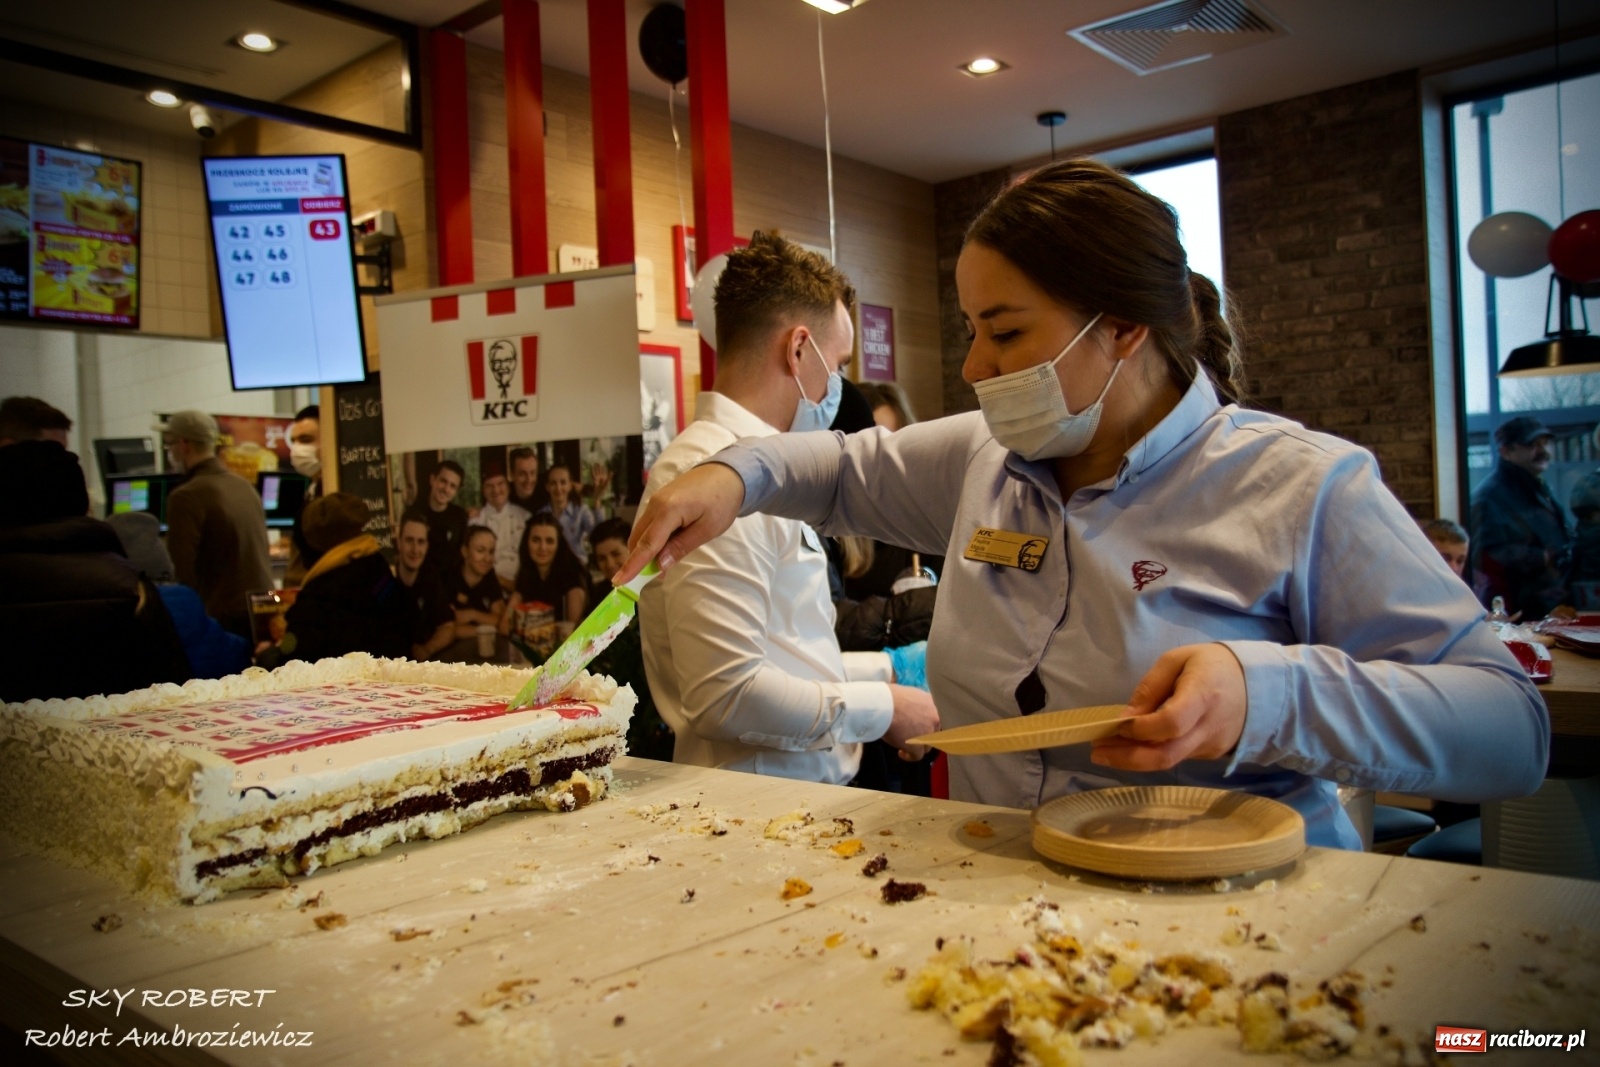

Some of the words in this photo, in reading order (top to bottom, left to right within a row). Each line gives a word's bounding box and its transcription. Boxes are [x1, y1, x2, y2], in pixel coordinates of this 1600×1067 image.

[229, 225, 250, 239] 42
[264, 224, 285, 238] 45
[314, 222, 336, 236] 43
[231, 249, 253, 262] 44
[267, 248, 288, 261] 46
[235, 271, 256, 285] 47
[270, 270, 291, 284] 48
[482, 400, 528, 421] KFC
[340, 446, 382, 466] BARTEK
[977, 529, 994, 538] KFC
